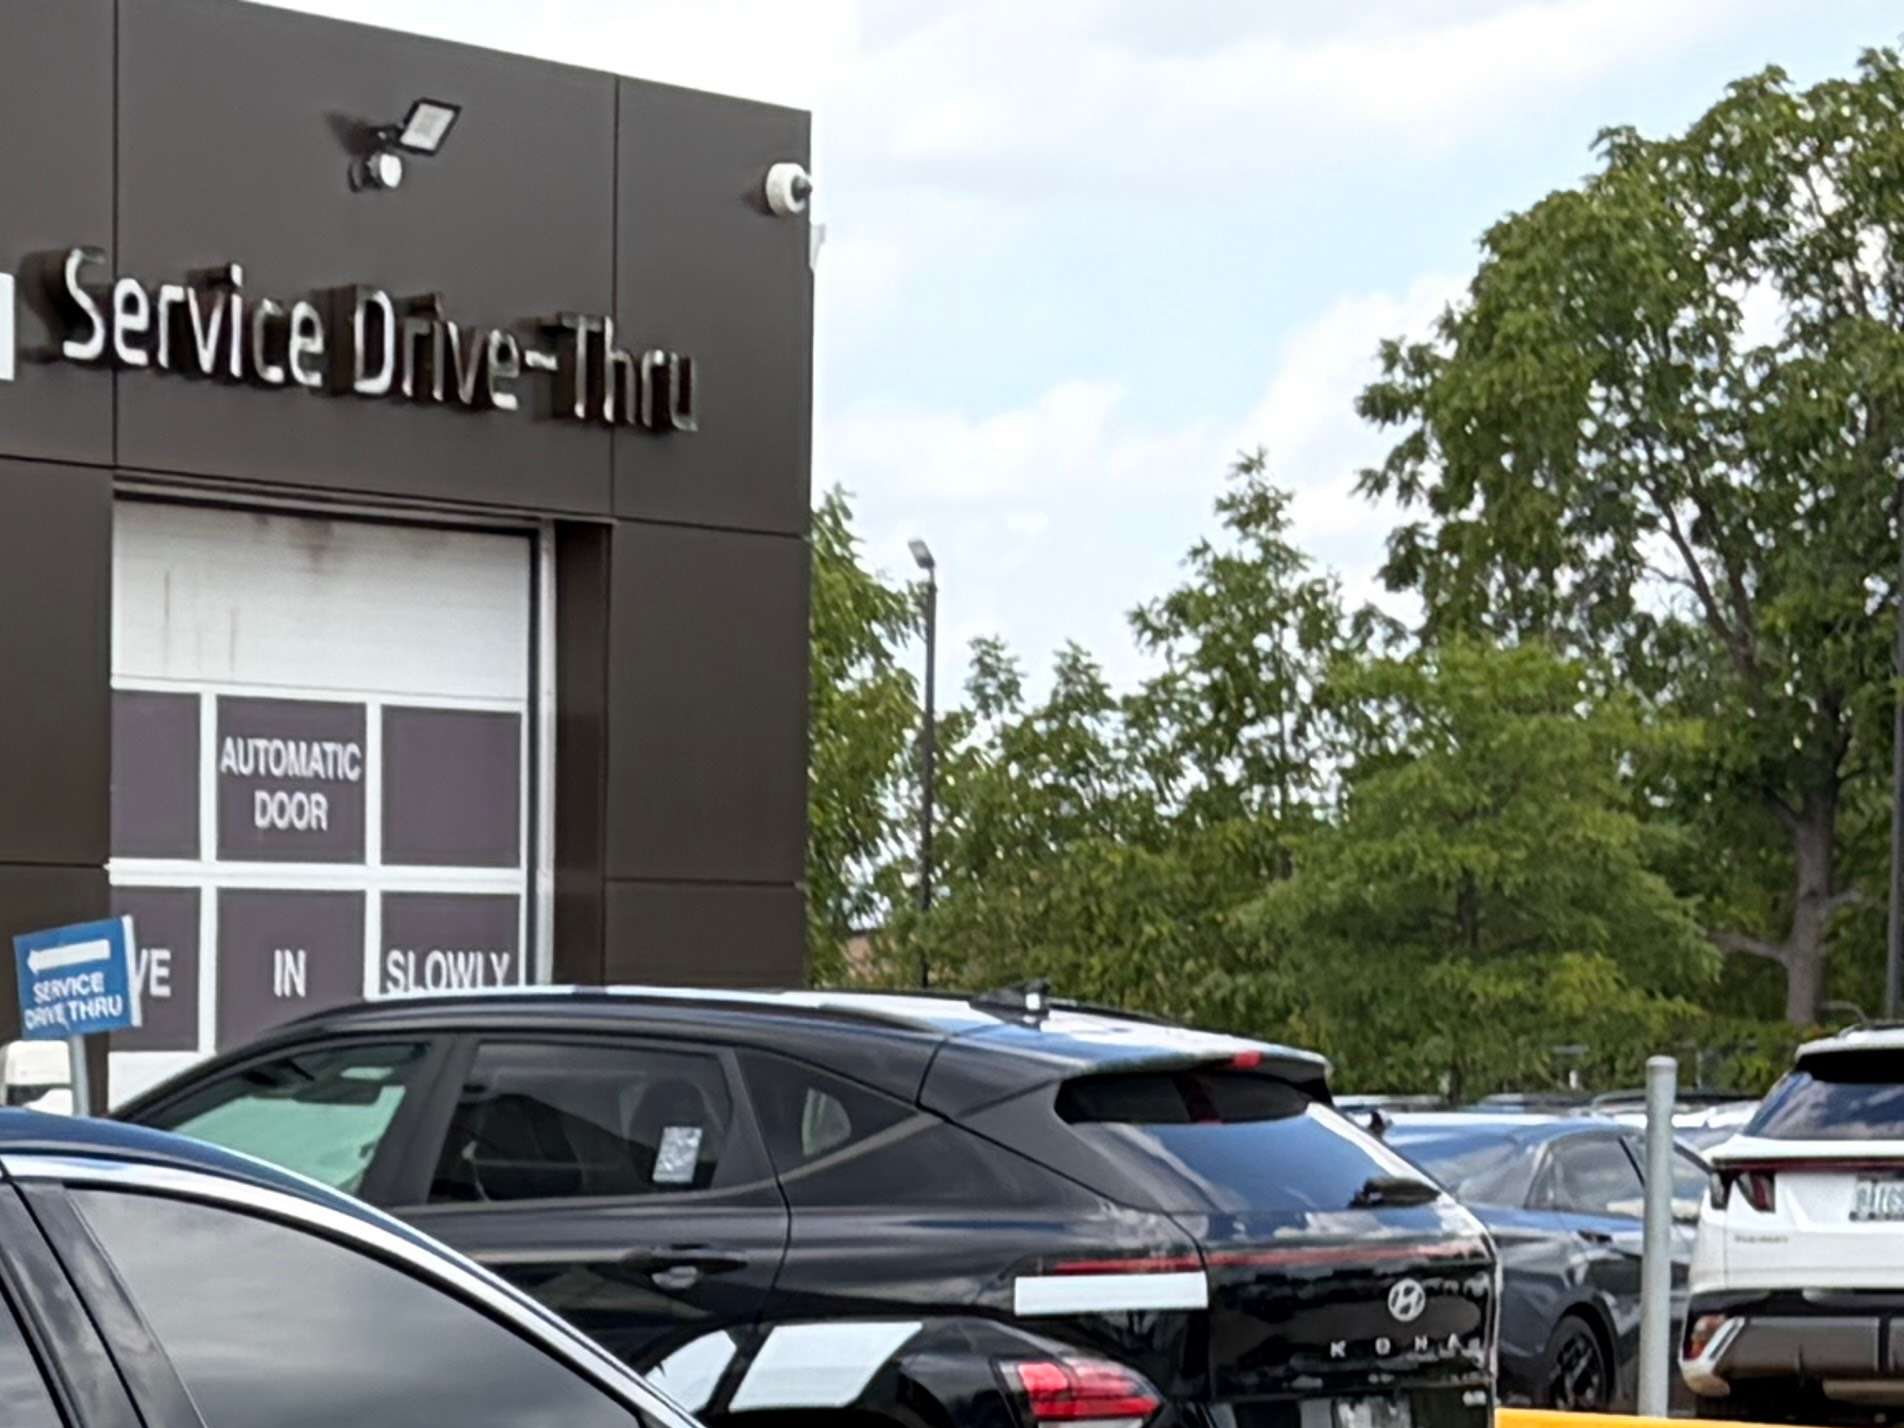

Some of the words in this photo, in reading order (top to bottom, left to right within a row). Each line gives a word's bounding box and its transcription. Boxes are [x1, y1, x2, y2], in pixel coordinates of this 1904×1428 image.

[62, 247, 324, 387] Service
[352, 289, 698, 431] Drive-Thru
[220, 737, 363, 782] AUTOMATIC
[254, 791, 328, 831] DOOR
[33, 971, 105, 1004] SERVICE
[273, 949, 307, 997] IN
[386, 949, 511, 995] SLOWLY
[24, 1002, 66, 1030] DRIVE
[68, 994, 124, 1021] THRU
[1330, 1332, 1462, 1359] KONA
